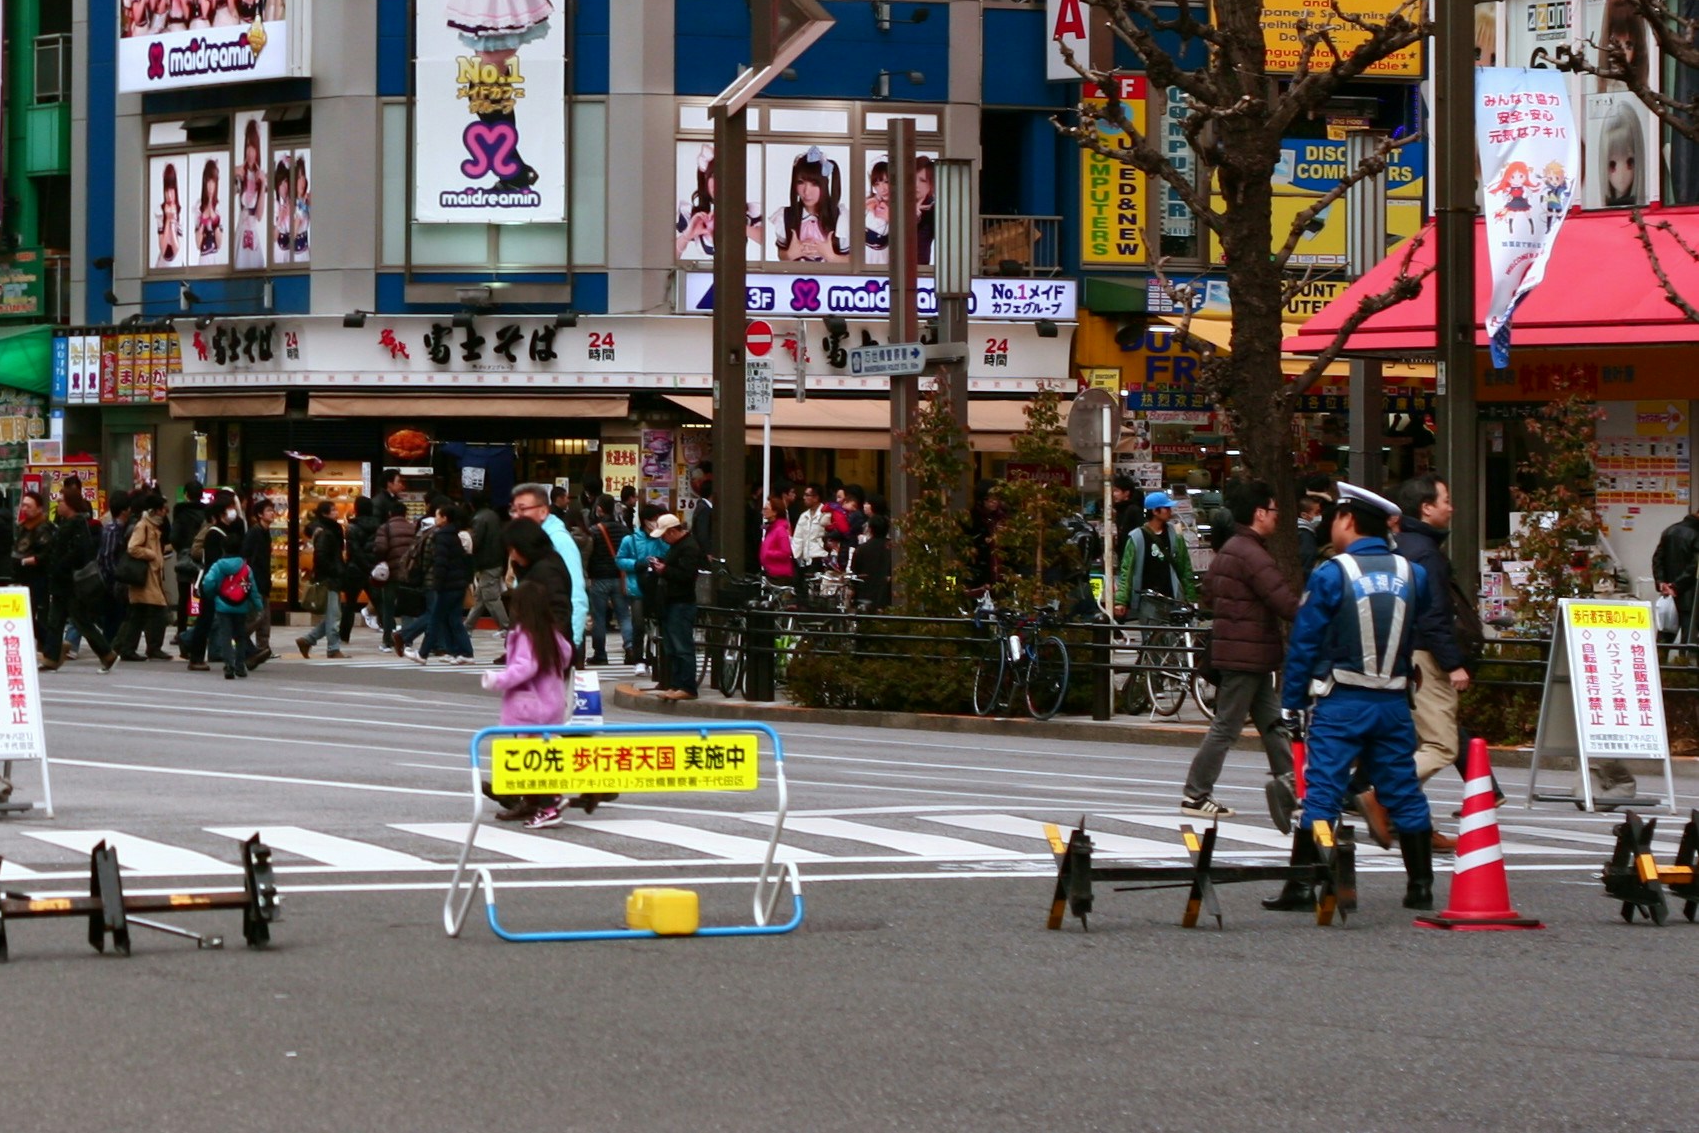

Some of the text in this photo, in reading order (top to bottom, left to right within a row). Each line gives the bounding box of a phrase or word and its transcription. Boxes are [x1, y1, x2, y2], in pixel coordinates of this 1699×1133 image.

[456, 56, 524, 84] No.1
[457, 86, 525, 99] メイドカフェ
[1483, 92, 1560, 108] みんなで協力
[1497, 110, 1554, 123] 安全・安心
[1488, 126, 1567, 144] 元気なアキバ
[442, 188, 538, 206] maidreamin
[1116, 138, 1139, 256] UED&NEW
[748, 283, 1065, 309] 3F No.1メイド
[991, 301, 1062, 315] カフェグループ
[285, 332, 298, 347] 24
[423, 324, 559, 364] 富士そば
[588, 332, 615, 348] 24
[985, 338, 1009, 354] 24
[588, 348, 615, 362] 時間
[984, 354, 1008, 367] 時間
[1358, 574, 1404, 595] 警視庁
[1574, 610, 1645, 624] 歩行者天国のルール
[3, 636, 28, 725] 物品販売禁止
[1582, 643, 1605, 726] 自転車走行禁止
[1606, 642, 1629, 726] パフォーマンス禁止
[1630, 644, 1654, 727] 物品販売禁止
[504, 744, 745, 772] この先 歩行者天国 実施中
